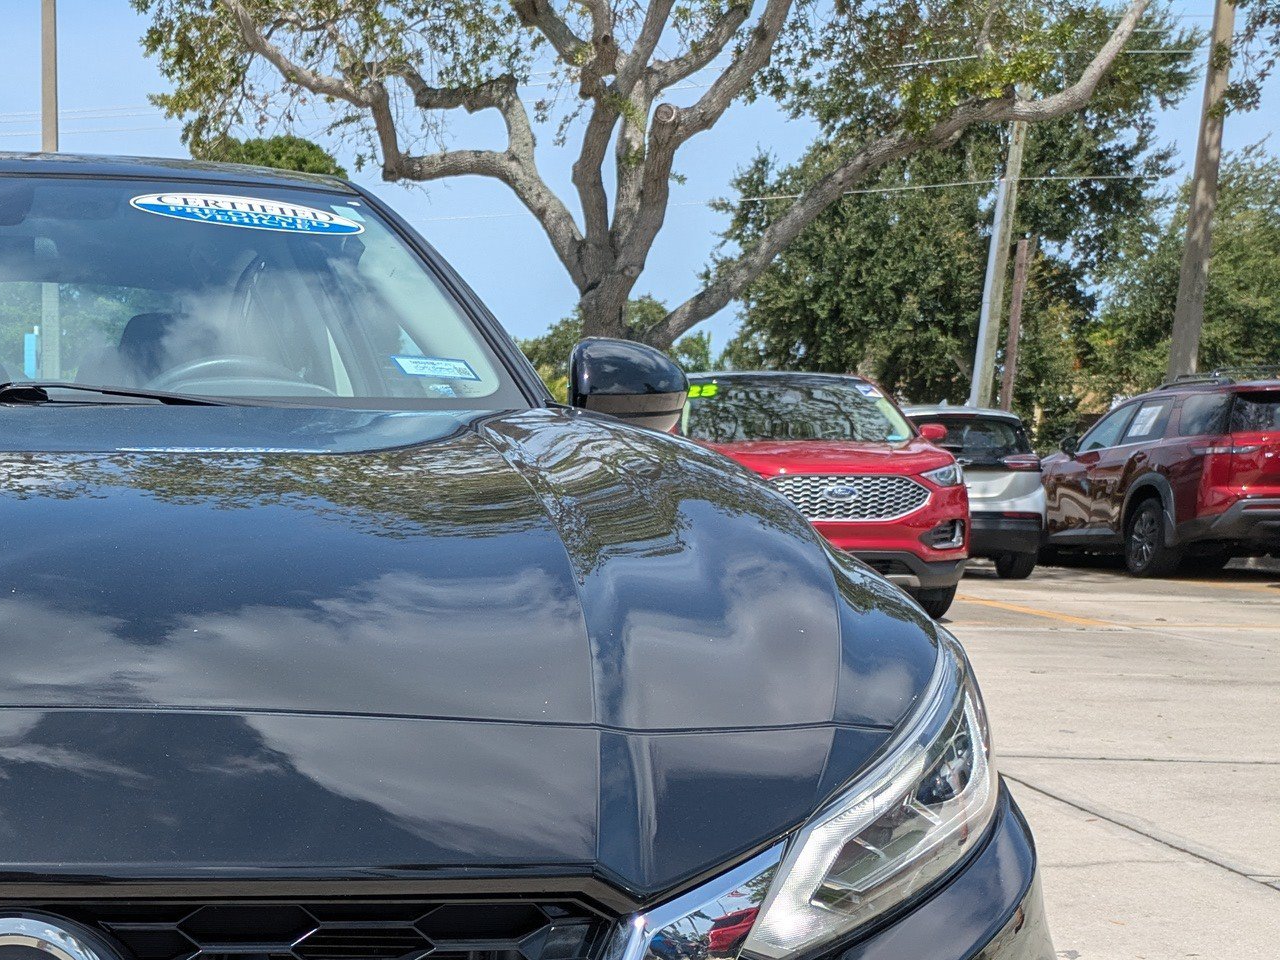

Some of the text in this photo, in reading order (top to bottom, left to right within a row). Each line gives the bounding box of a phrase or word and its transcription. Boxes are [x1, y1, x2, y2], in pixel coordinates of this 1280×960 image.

[157, 195, 334, 221] CERTIFIED
[169, 206, 331, 229] PRE-OWNED
[193, 212, 311, 231] VEHICLE
